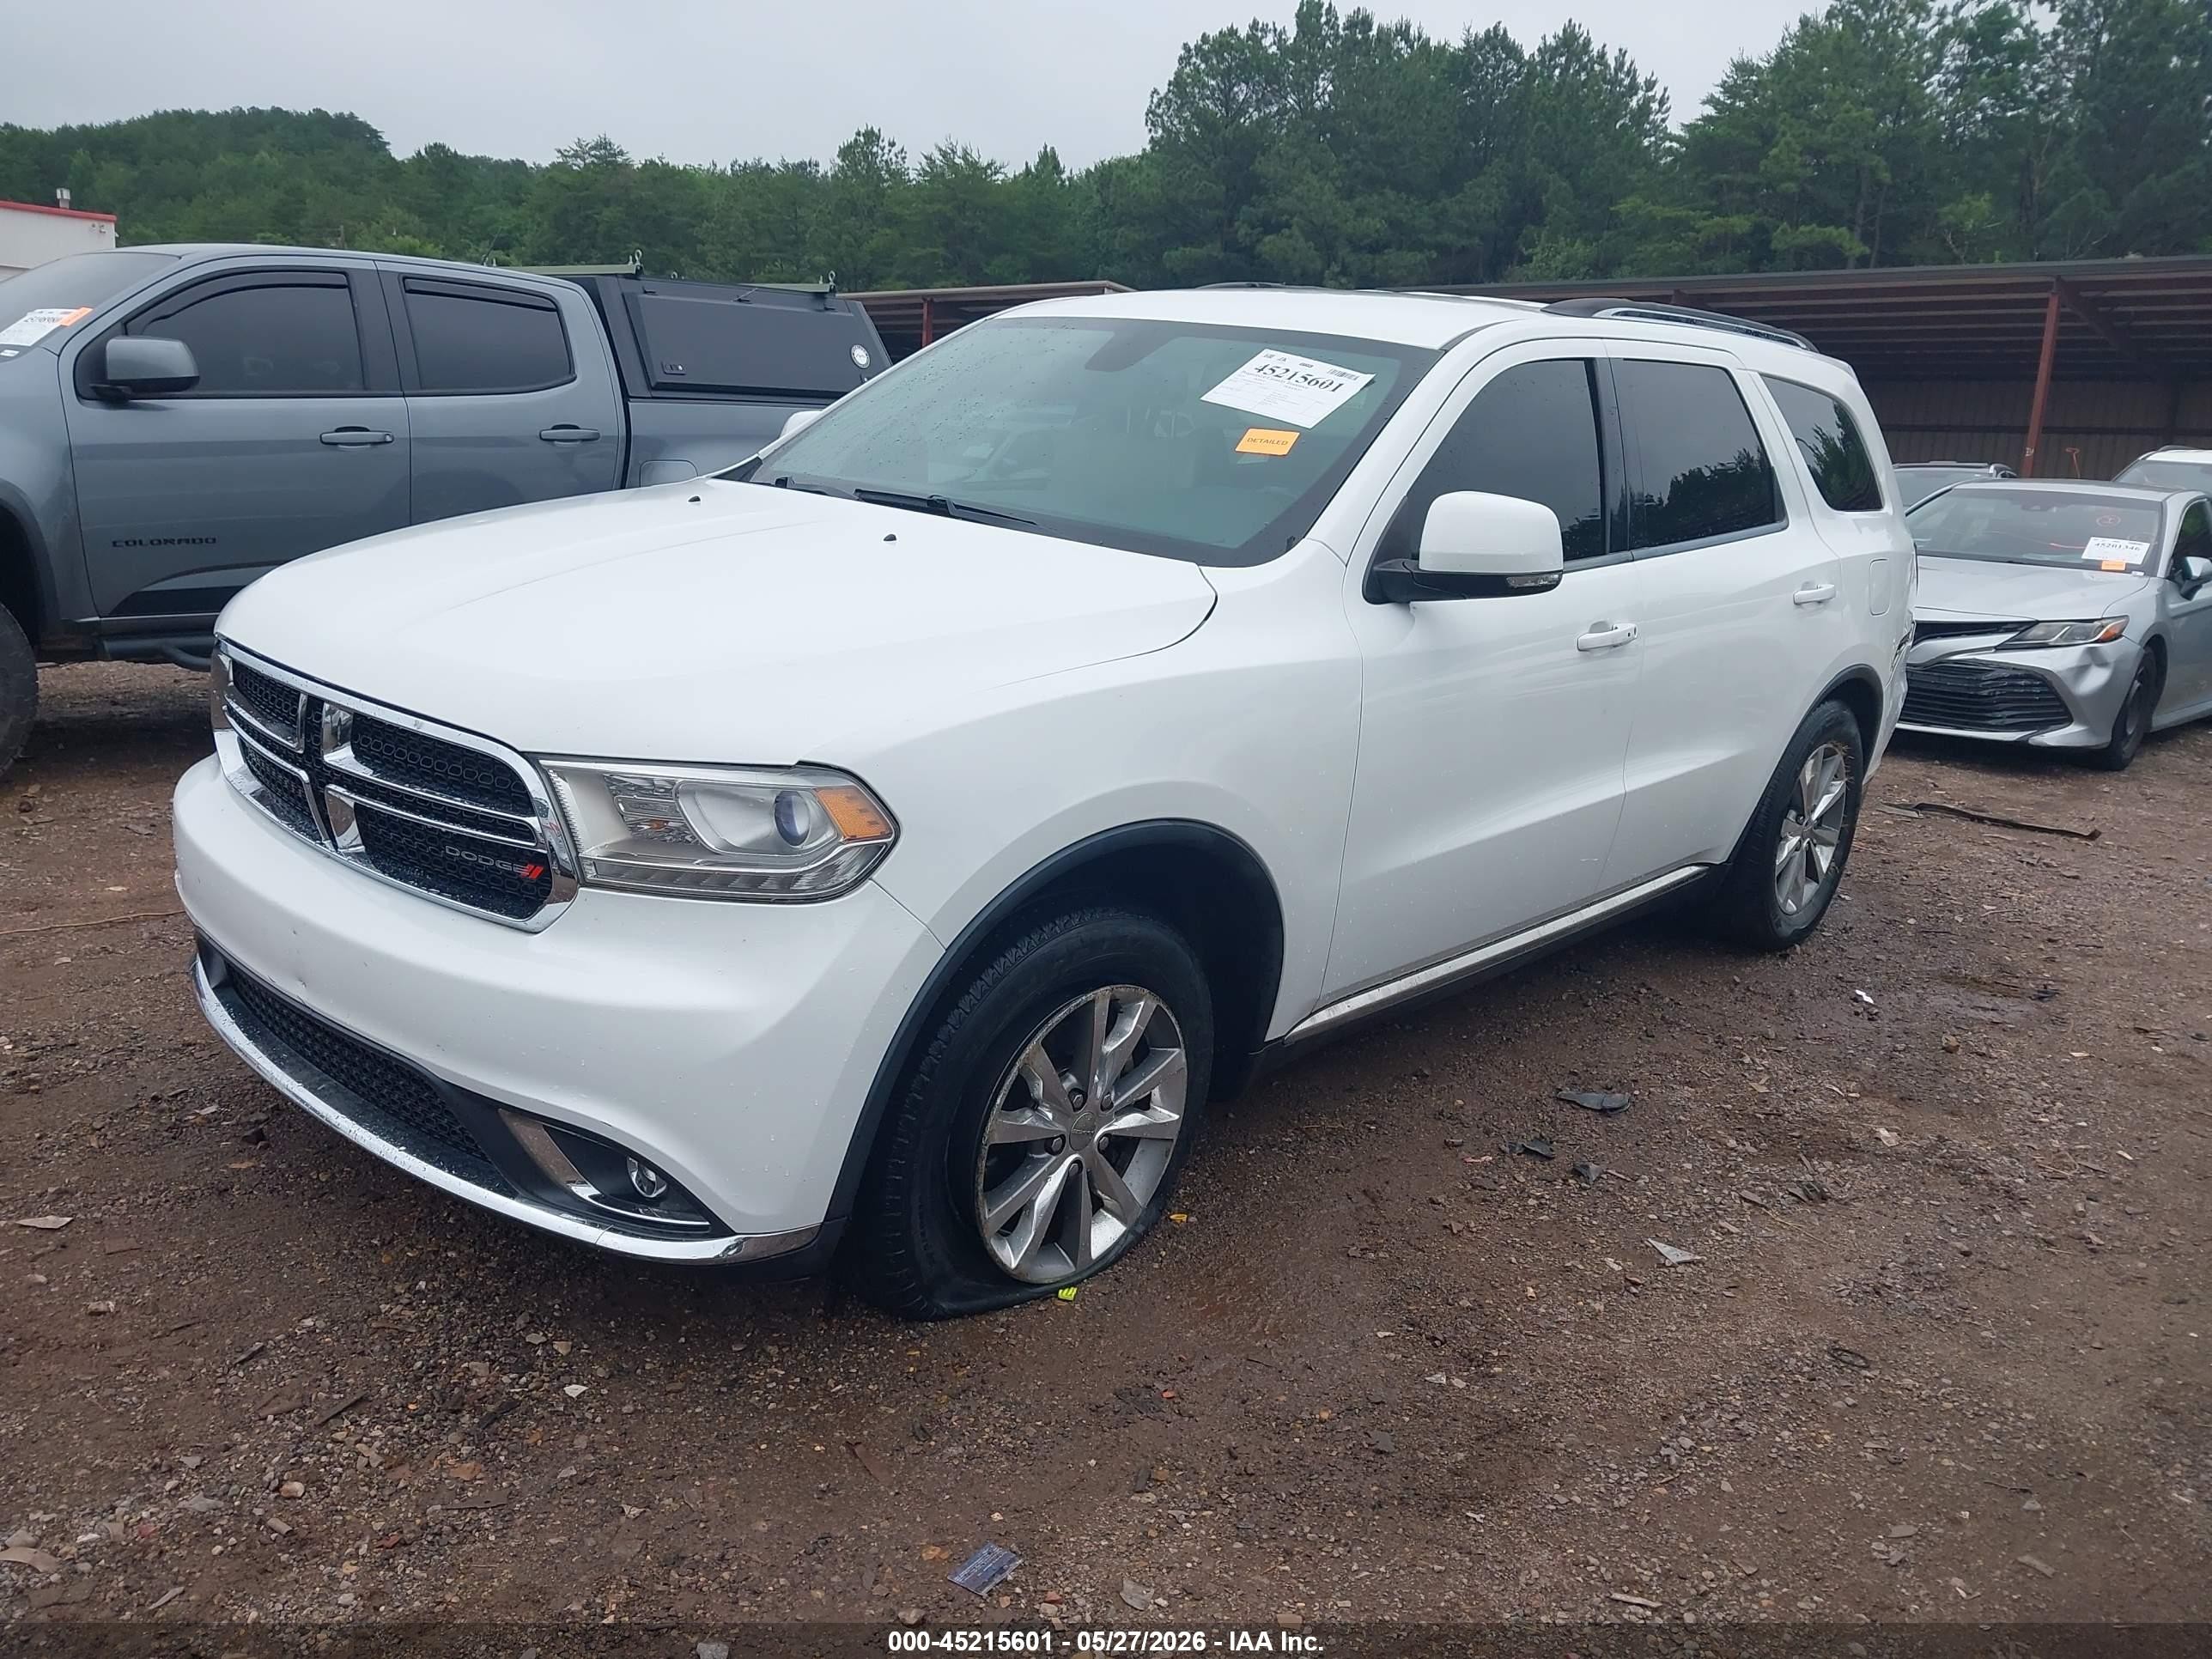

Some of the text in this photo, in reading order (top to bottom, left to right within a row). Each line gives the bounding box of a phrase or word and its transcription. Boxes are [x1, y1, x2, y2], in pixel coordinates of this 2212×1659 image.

[1255, 363, 1345, 392] 45215601
[1247, 437, 1290, 446] DETAILED
[111, 537, 217, 548] COLORADO
[445, 845, 530, 876] DODGE
